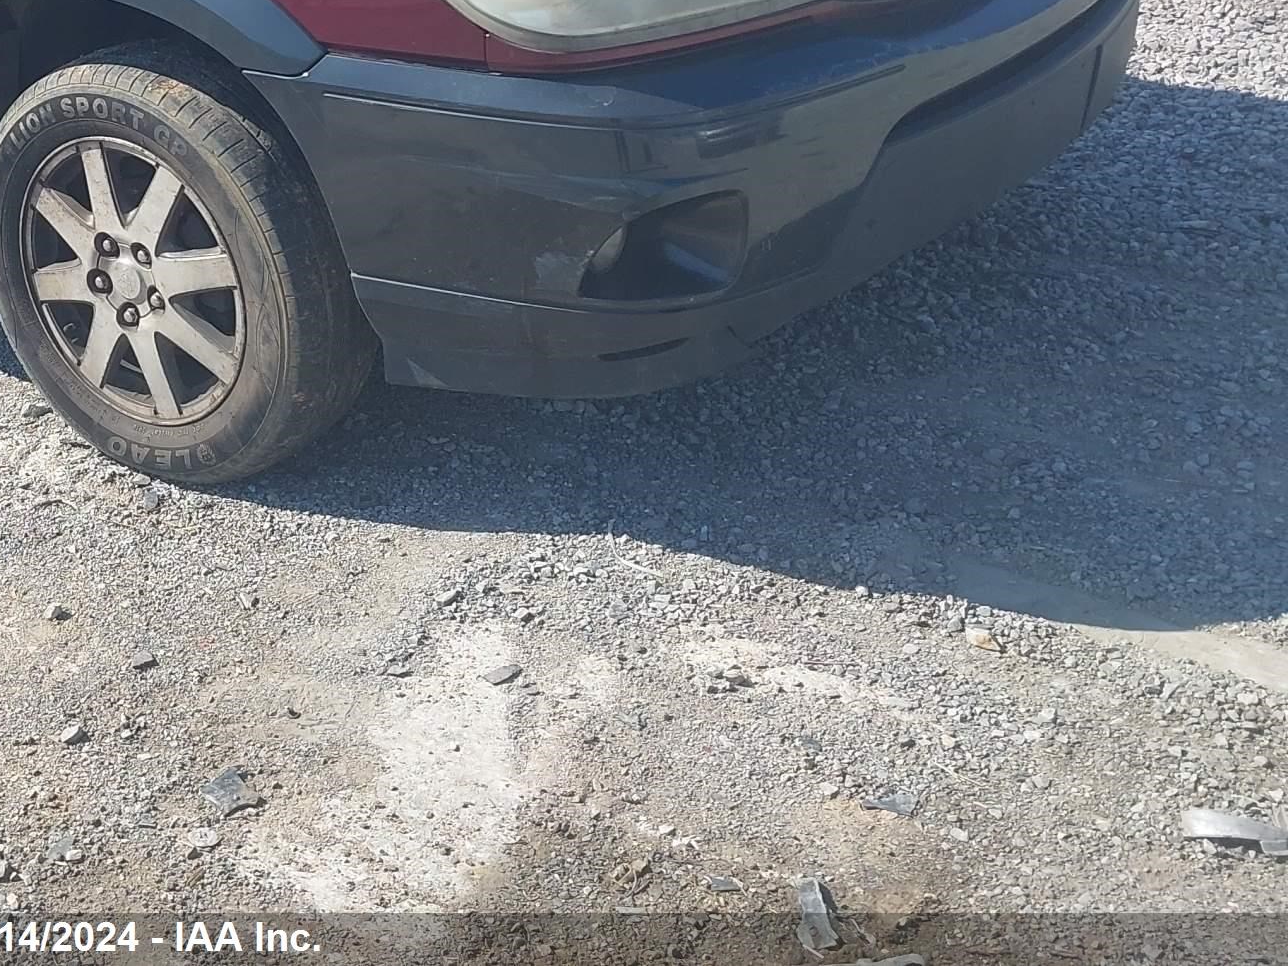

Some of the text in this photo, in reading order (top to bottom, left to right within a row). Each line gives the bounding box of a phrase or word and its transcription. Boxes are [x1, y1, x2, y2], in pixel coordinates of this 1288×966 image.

[9, 104, 57, 151] LION
[60, 96, 145, 130] SPORT
[107, 435, 193, 469] LEAO
